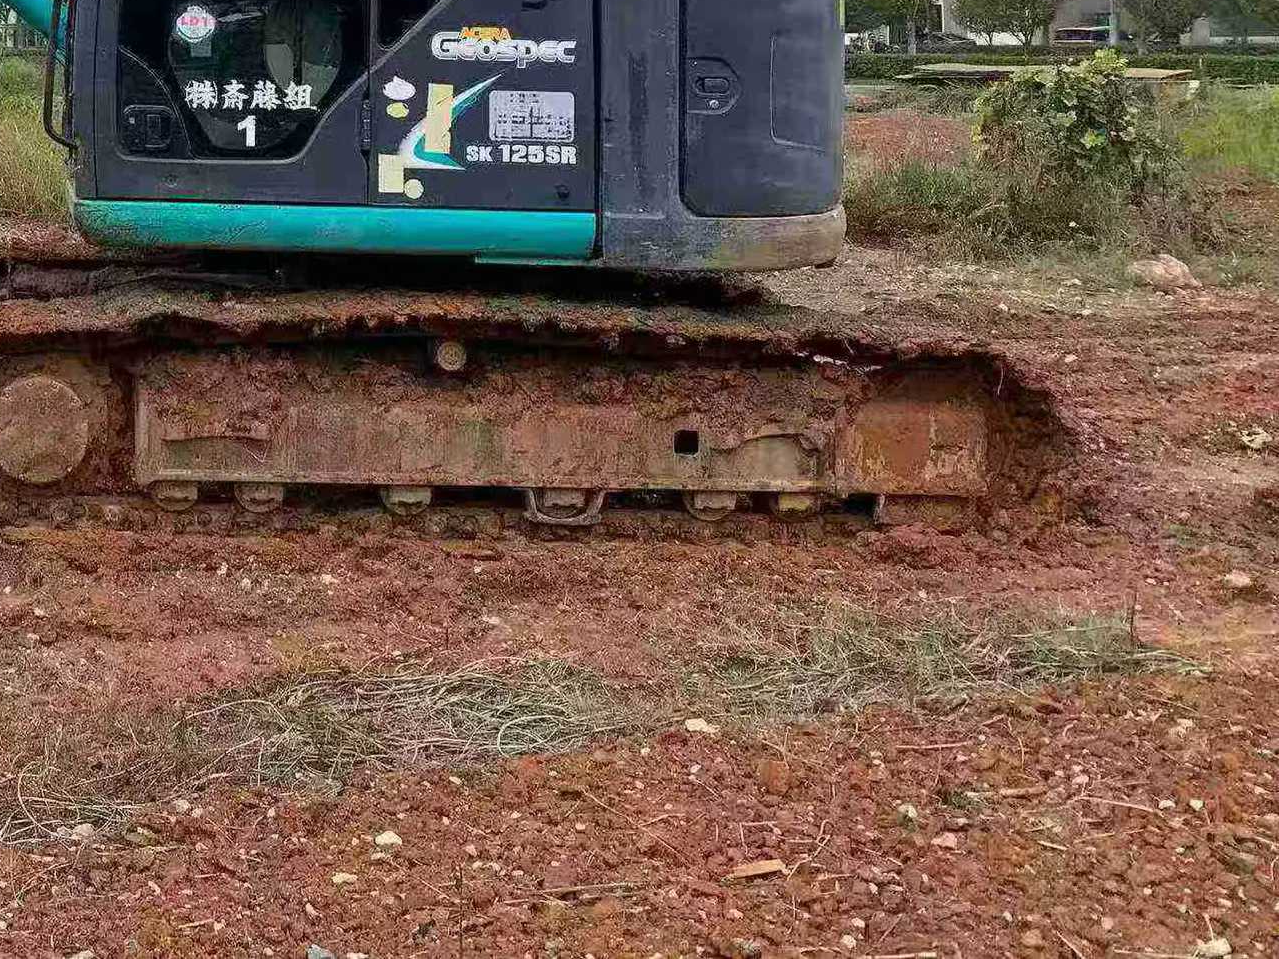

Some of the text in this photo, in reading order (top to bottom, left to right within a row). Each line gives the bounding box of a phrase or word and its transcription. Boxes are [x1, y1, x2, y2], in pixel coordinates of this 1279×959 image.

[431, 30, 577, 69] Geospec
[237, 115, 257, 147] 1
[465, 144, 577, 165] SK 125SR
